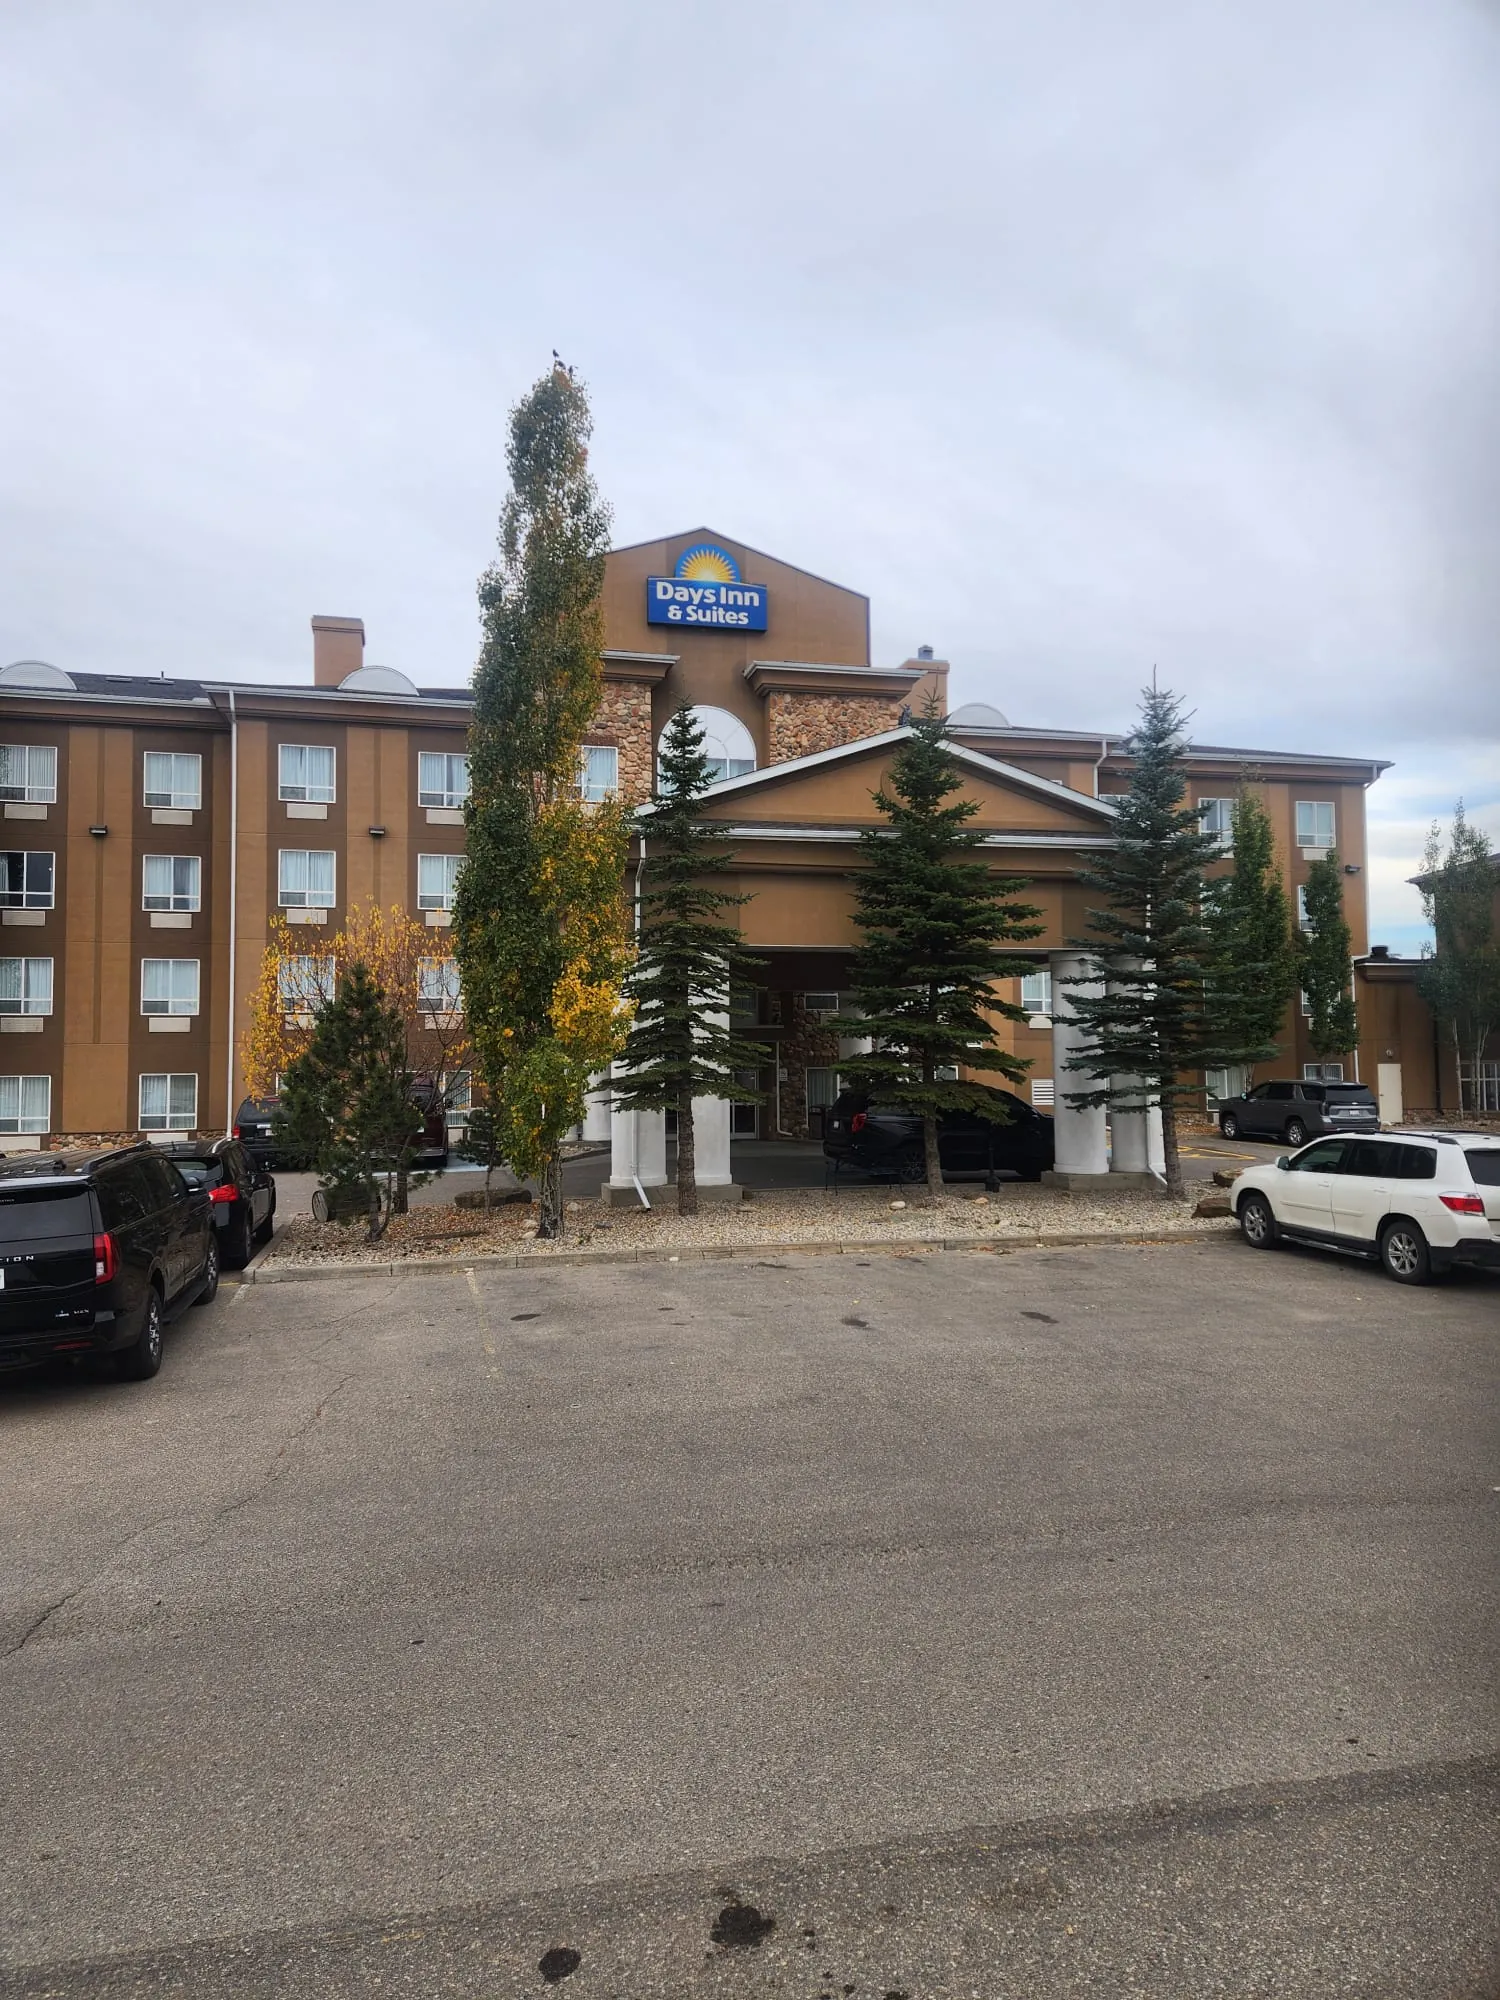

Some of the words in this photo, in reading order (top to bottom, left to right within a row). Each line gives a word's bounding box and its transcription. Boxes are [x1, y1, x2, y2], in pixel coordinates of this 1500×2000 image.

[656, 581, 716, 605] Days
[720, 586, 760, 607] Inn
[667, 605, 682, 620] &
[686, 605, 749, 625] Suites
